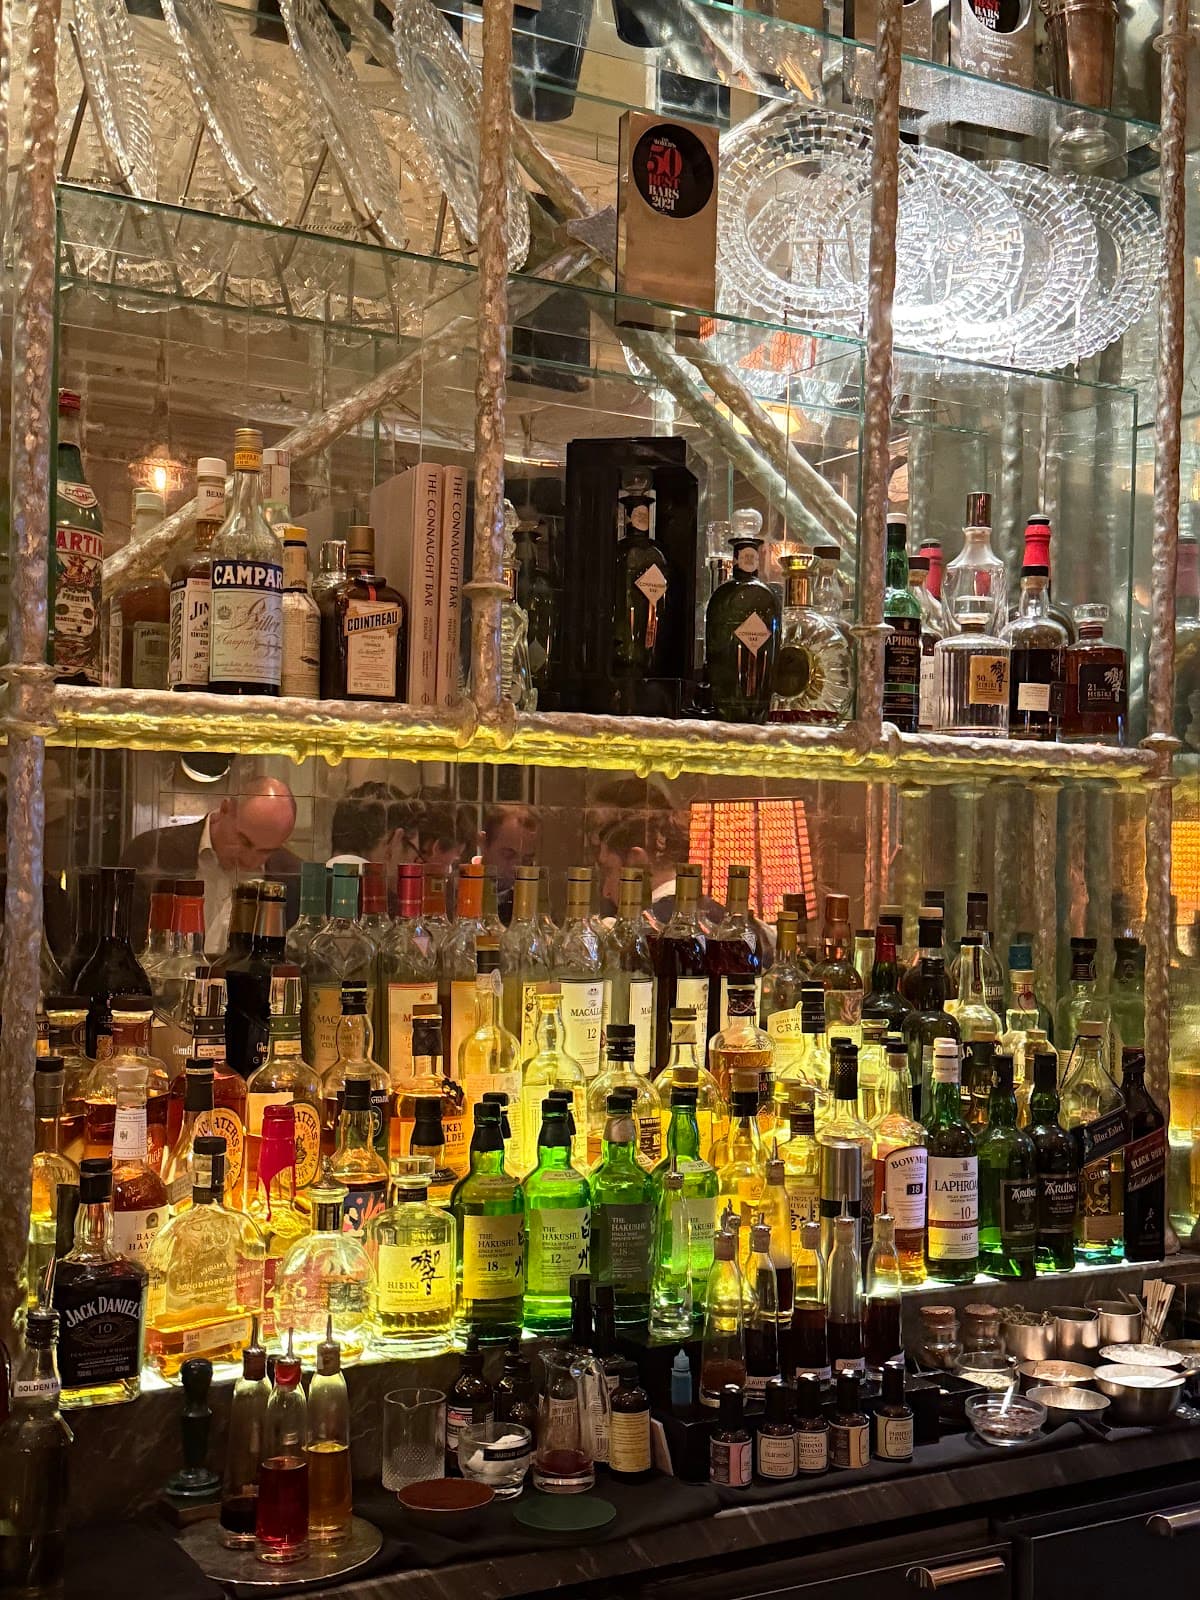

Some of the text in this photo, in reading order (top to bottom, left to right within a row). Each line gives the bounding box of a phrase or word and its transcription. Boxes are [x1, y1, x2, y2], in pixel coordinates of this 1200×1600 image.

[974, 5, 1000, 20] BARS
[647, 144, 682, 178] 50
[648, 173, 680, 189] BEST
[648, 184, 680, 200] BARS
[651, 195, 675, 211] 2021
[428, 473, 437, 496] THE
[425, 499, 437, 579] CONNAUGHT
[448, 476, 463, 608] THE CONNAUGHT BAR
[424, 583, 434, 607] BAR
[347, 610, 398, 632] COINTREAU
[899, 655, 910, 665] 25
[1087, 683, 1097, 691] 21
[586, 1028, 598, 1040] 12
[1093, 1121, 1125, 1144] Blue Label
[1130, 1154, 1150, 1169] BLACK
[911, 1184, 921, 1194] 18
[961, 1206, 971, 1219] 10
[542, 1232, 580, 1241] HAKUSHU
[487, 1261, 499, 1271] 18
[551, 1253, 561, 1264] 12
[387, 1281, 420, 1290] HIBIKI
[65, 1300, 98, 1328] JACK
